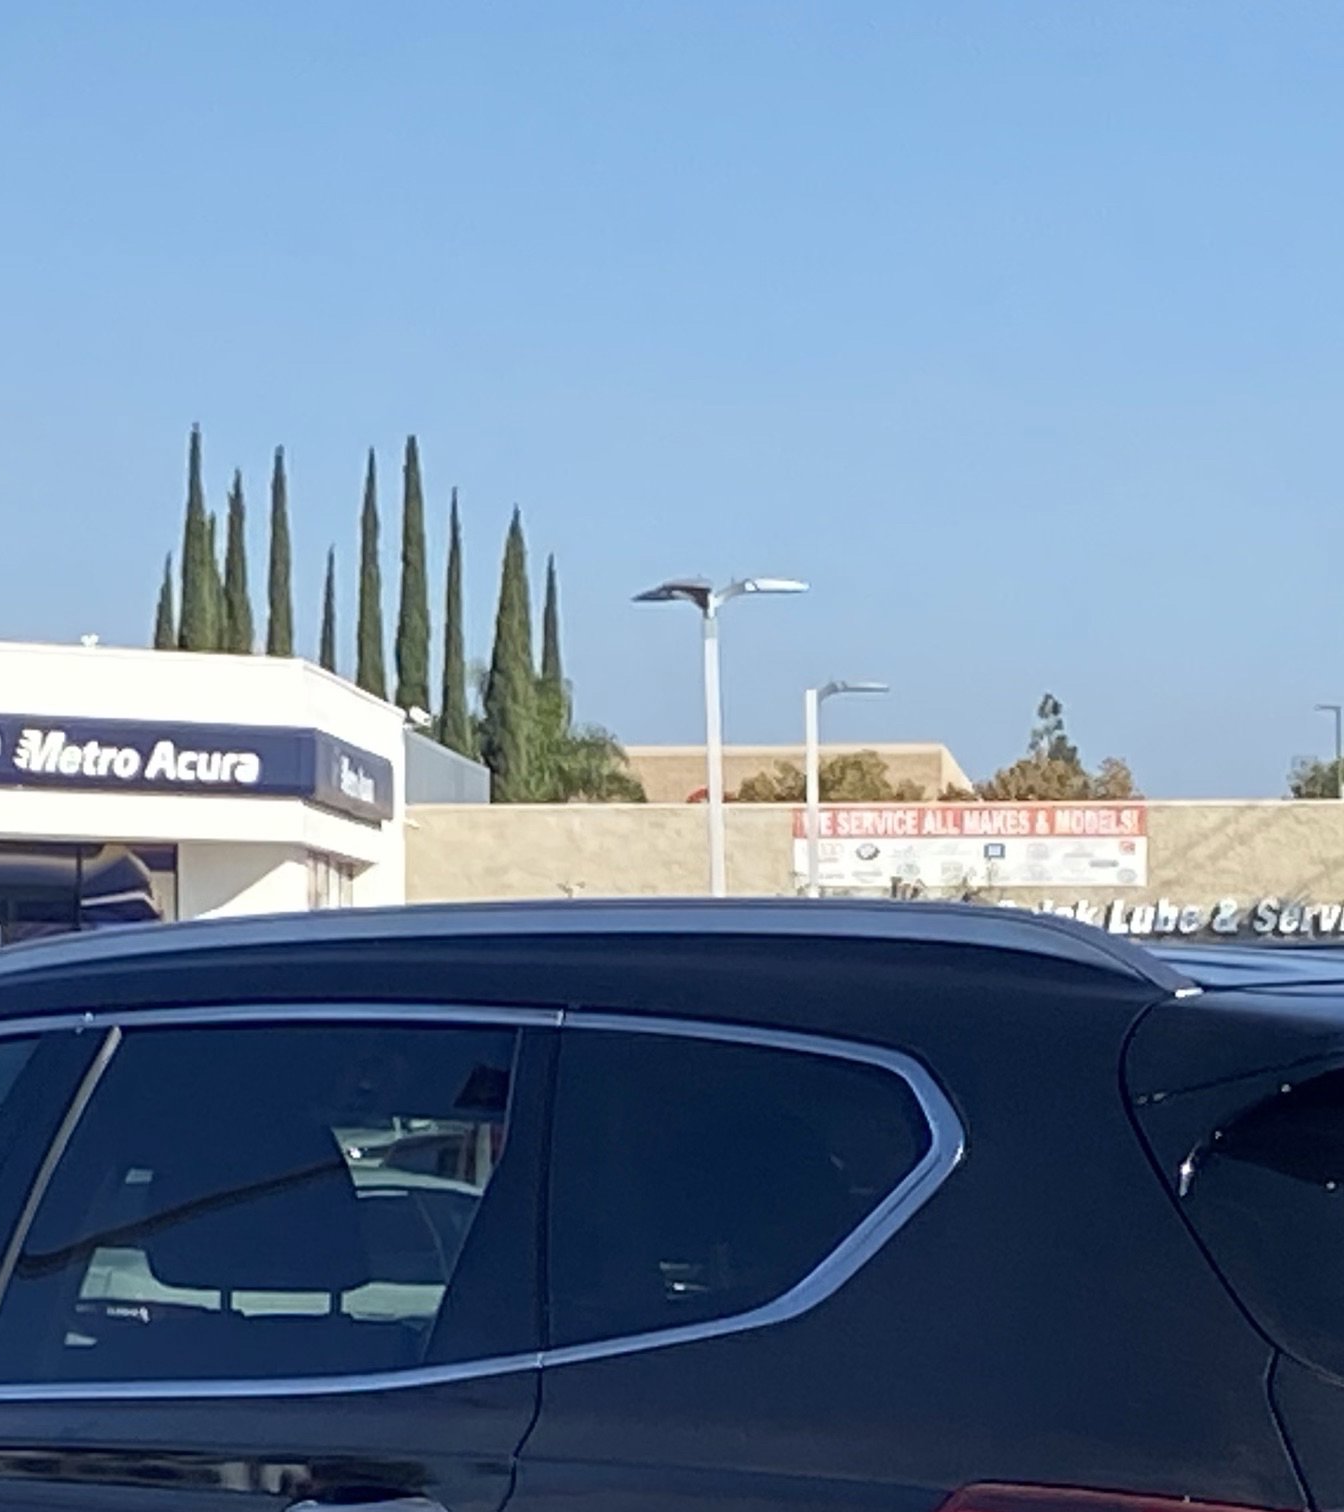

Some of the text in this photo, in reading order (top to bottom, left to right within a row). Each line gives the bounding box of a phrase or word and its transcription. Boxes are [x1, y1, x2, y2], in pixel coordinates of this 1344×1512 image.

[13, 728, 142, 779] Metro
[144, 740, 261, 784] Acura
[836, 809, 919, 835] SERVICE
[922, 809, 961, 835] ALL
[963, 809, 1030, 835] MAKES
[1035, 809, 1051, 835] &
[1056, 809, 1140, 835] MODELS!
[1109, 899, 1201, 934] Lube
[1213, 898, 1239, 933] &
